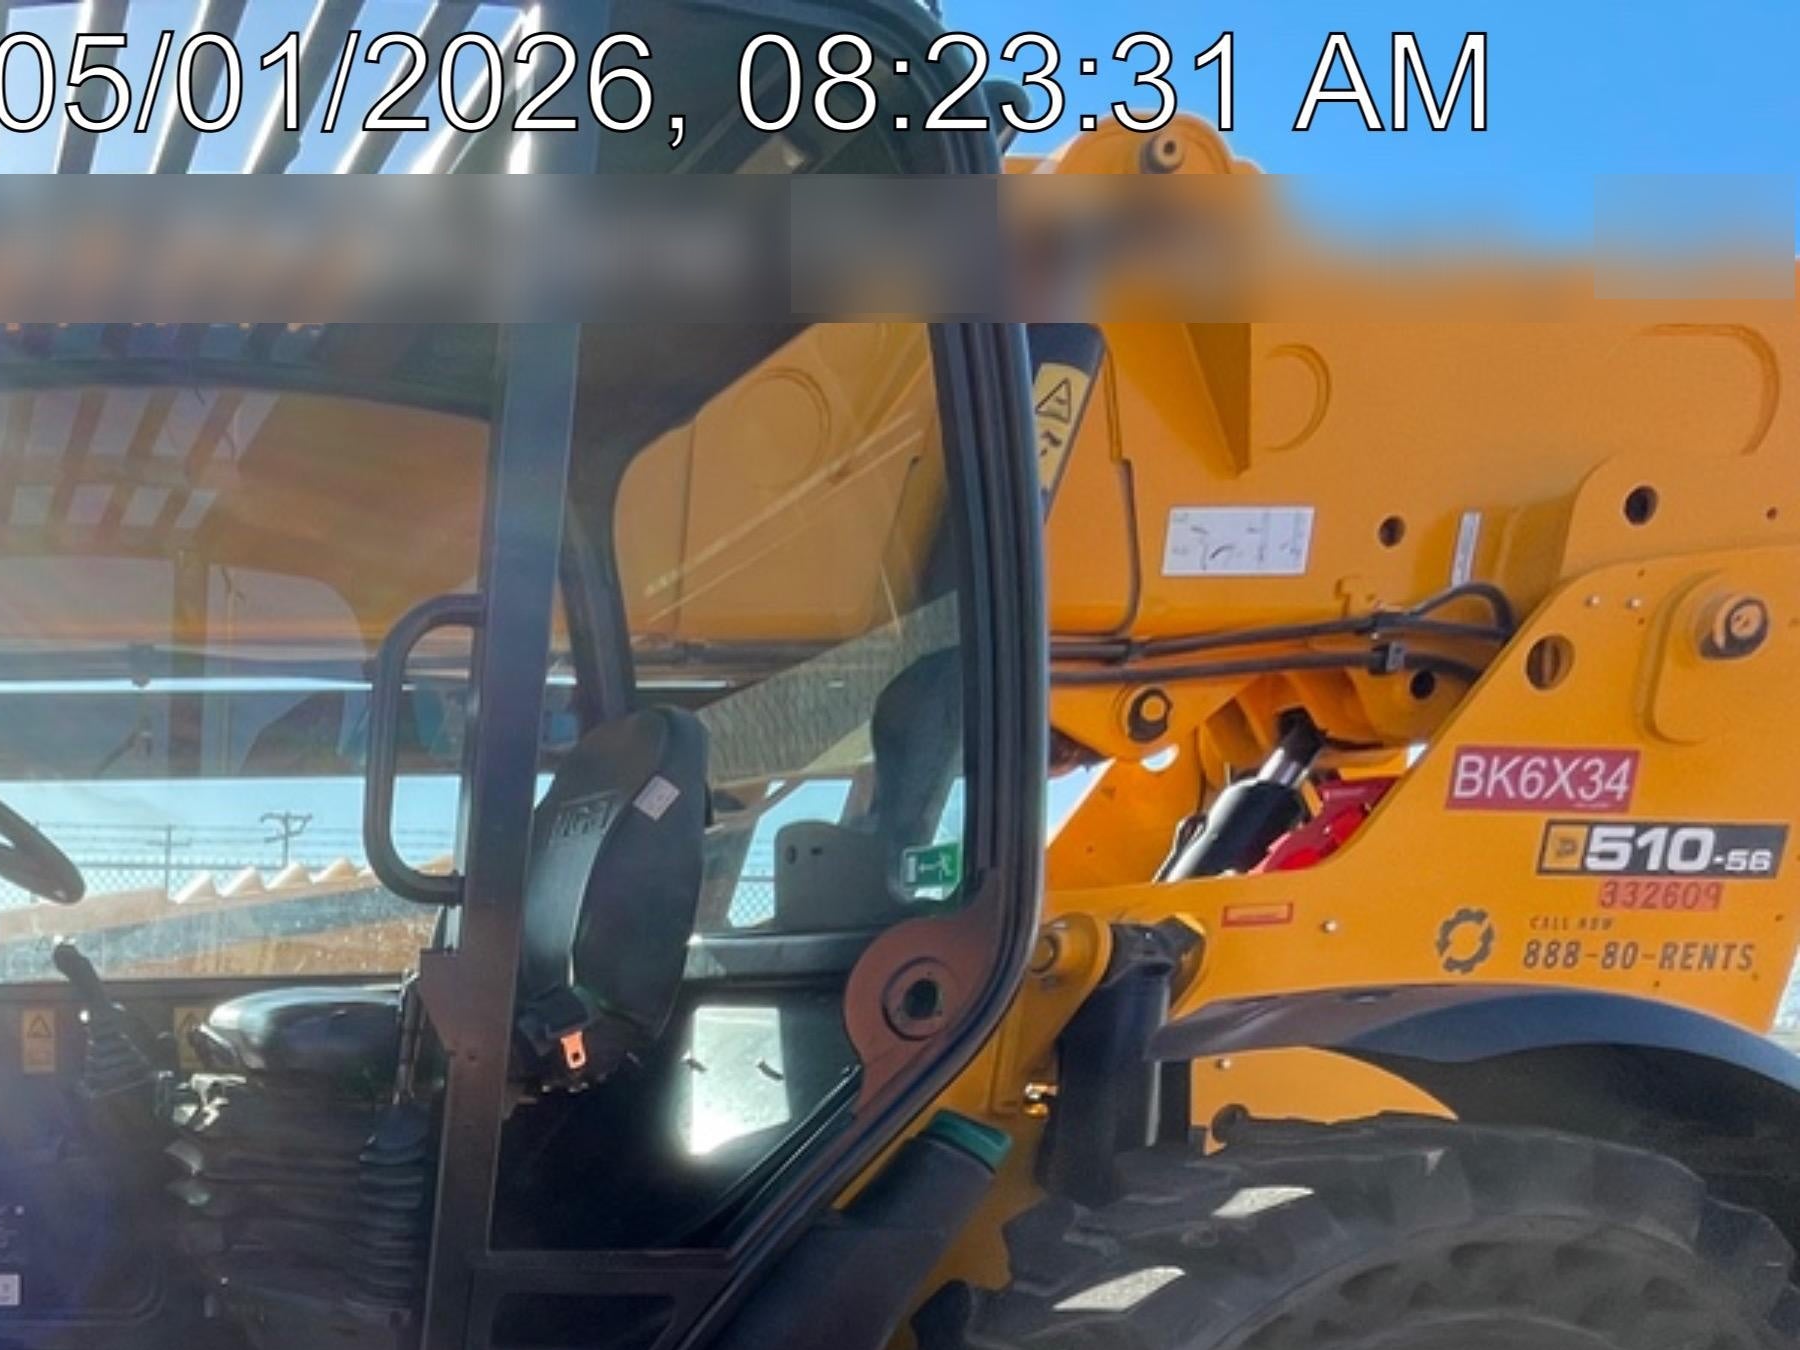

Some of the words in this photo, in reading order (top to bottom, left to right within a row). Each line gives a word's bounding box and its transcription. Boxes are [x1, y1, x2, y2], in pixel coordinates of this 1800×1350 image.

[1453, 755, 1632, 801] BK6X34
[1600, 880, 1724, 910] 332609
[1523, 939, 1756, 971] 888-80-RENTS
